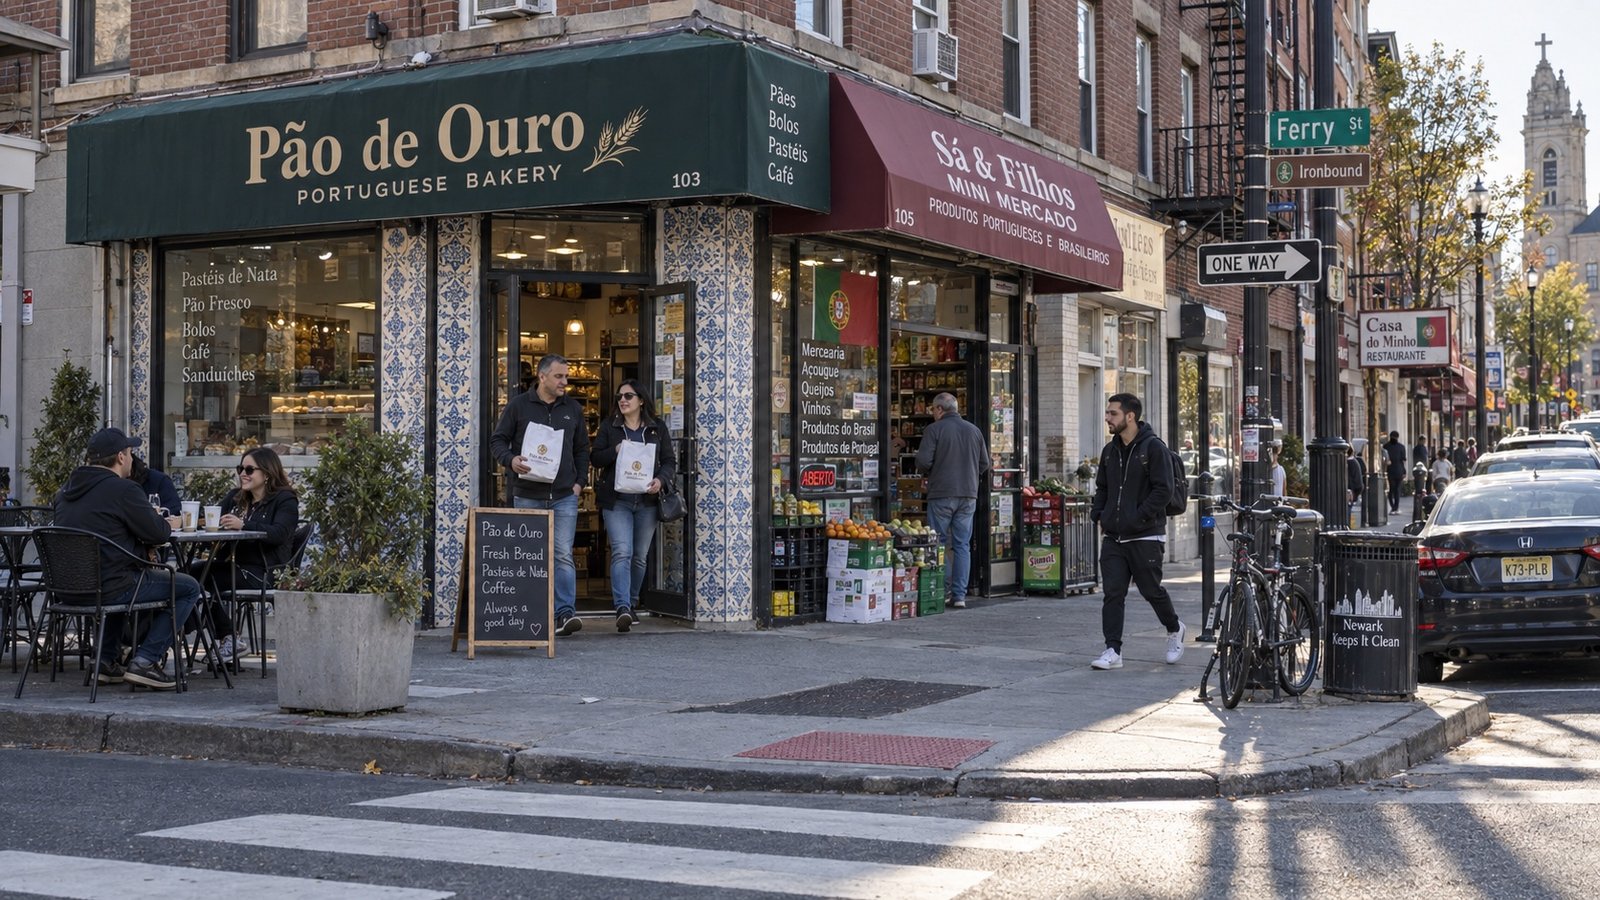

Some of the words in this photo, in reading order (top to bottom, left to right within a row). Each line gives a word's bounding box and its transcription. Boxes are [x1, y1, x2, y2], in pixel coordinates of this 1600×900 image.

[770, 83, 796, 108] Pães
[768, 109, 799, 135] Bolos
[1277, 117, 1335, 145] Ferry
[1349, 116, 1363, 131] St
[245, 120, 342, 185] Pão
[362, 117, 419, 172] de
[438, 103, 585, 163] Ouro
[768, 136, 808, 163] Pastéis
[768, 162, 794, 185] Café
[931, 130, 971, 174] Sá
[972, 146, 996, 182] &
[996, 154, 1076, 211] Filhos
[1299, 162, 1363, 179] Ironbound
[297, 176, 447, 205] PORTUGUESE
[466, 164, 562, 189] BAKERY
[672, 171, 701, 189] 103
[946, 173, 990, 204] MINI
[996, 190, 1078, 232] MERCADO
[894, 208, 915, 227] 105
[929, 197, 979, 225] PRODUTOS
[983, 213, 1043, 246] PORTUGUESES
[1046, 234, 1052, 248] E
[1058, 238, 1110, 266] BRASILEIROS
[1212, 255, 1243, 272] ONE
[1248, 254, 1280, 271] WAY
[182, 269, 225, 287] Pastéis
[228, 267, 243, 284] de
[246, 266, 278, 283] Nata
[182, 296, 205, 313] Pão
[208, 295, 252, 311] Fresco
[182, 320, 216, 338] Bolos
[1366, 317, 1403, 333] Casa
[1366, 336, 1379, 348] do
[1382, 335, 1417, 348] Minho
[182, 343, 211, 360] Café
[801, 342, 845, 360] Mercearia
[1366, 350, 1426, 362] RESTAURANTE
[182, 365, 256, 383] Sanduíches
[801, 361, 839, 380] Açougue
[801, 381, 835, 399] Queijos
[801, 400, 832, 416] Vinhos
[801, 420, 840, 436] Produtos
[841, 422, 852, 436] do
[853, 422, 876, 436] Brasil
[801, 440, 839, 455] Produtos
[840, 441, 850, 455] de
[851, 441, 880, 457] Portugal
[801, 470, 836, 486] ABERTO
[482, 520, 501, 537] Pão
[503, 523, 516, 538] de
[518, 523, 544, 539] Ouro
[482, 545, 510, 560] Fresh
[514, 546, 544, 561] Bread
[482, 563, 514, 578] Pastéis
[516, 566, 527, 578] de
[529, 565, 548, 578] Nata
[1505, 563, 1548, 577] K73-PLB
[482, 580, 516, 594] Coffee
[483, 601, 518, 616] Always
[521, 604, 528, 612] a
[484, 616, 505, 632] good
[508, 616, 525, 631] day
[1343, 618, 1383, 632] Newark
[1332, 632, 1359, 649] Keeps
[1361, 634, 1369, 647] It
[1371, 634, 1400, 648] Clean
